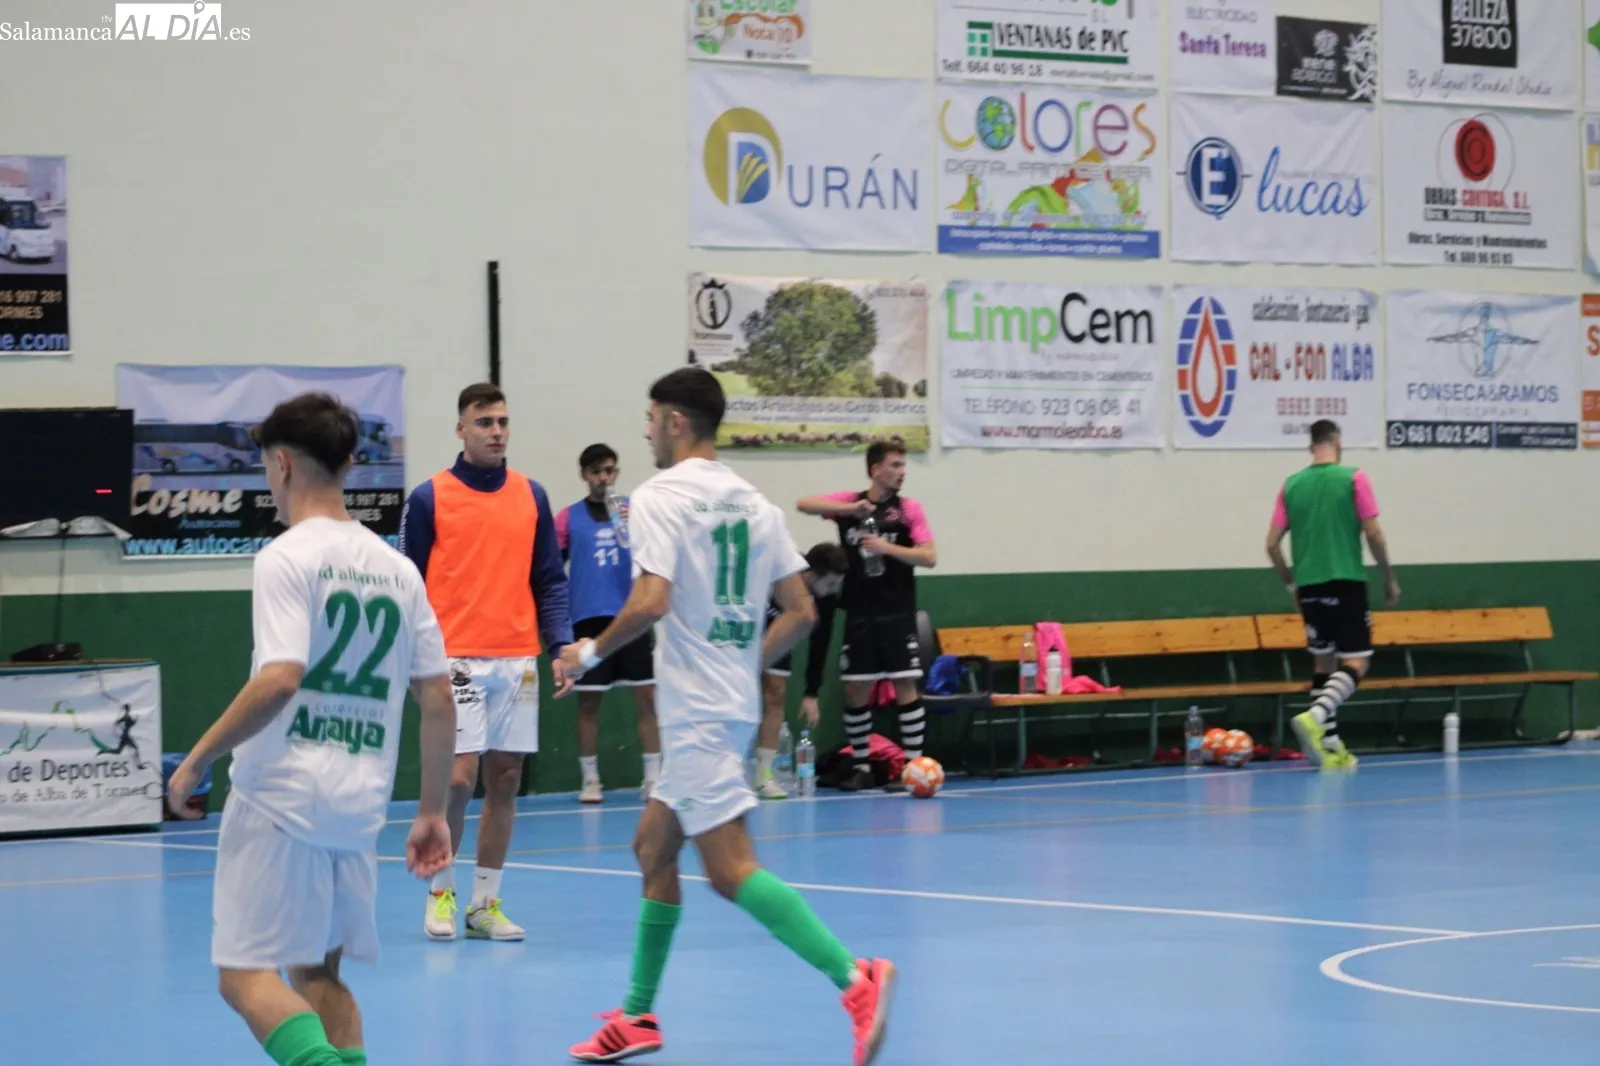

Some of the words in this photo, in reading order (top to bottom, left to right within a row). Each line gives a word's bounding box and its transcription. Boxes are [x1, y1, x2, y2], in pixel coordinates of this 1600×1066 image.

[997, 22, 1073, 49] VENTANAS
[1077, 26, 1097, 51] de
[1101, 29, 1130, 53] PVC
[1179, 31, 1220, 55] Santa
[1222, 33, 1268, 58] Teresa
[1451, 24, 1513, 49] 37800
[939, 91, 1157, 156] colores
[1256, 146, 1368, 218] lucas
[1424, 187, 1457, 206] OBRAS
[1435, 232, 1474, 247] Servicios
[945, 288, 1155, 353] LimpCem
[1249, 341, 1282, 381] CAL
[1294, 341, 1327, 381] FON
[1331, 341, 1374, 381] ALBA
[1041, 399, 1071, 416] 923
[1126, 399, 1142, 416] 41
[131, 474, 244, 517] Cosme
[593, 547, 620, 567] 11
[712, 518, 749, 605] 11
[300, 591, 401, 702] 22
[285, 704, 386, 755] Anaya
[8, 761, 33, 784] de
[40, 757, 131, 785] Deportes
[11, 789, 29, 802] de
[36, 787, 67, 801] Alba
[72, 786, 89, 801] de
